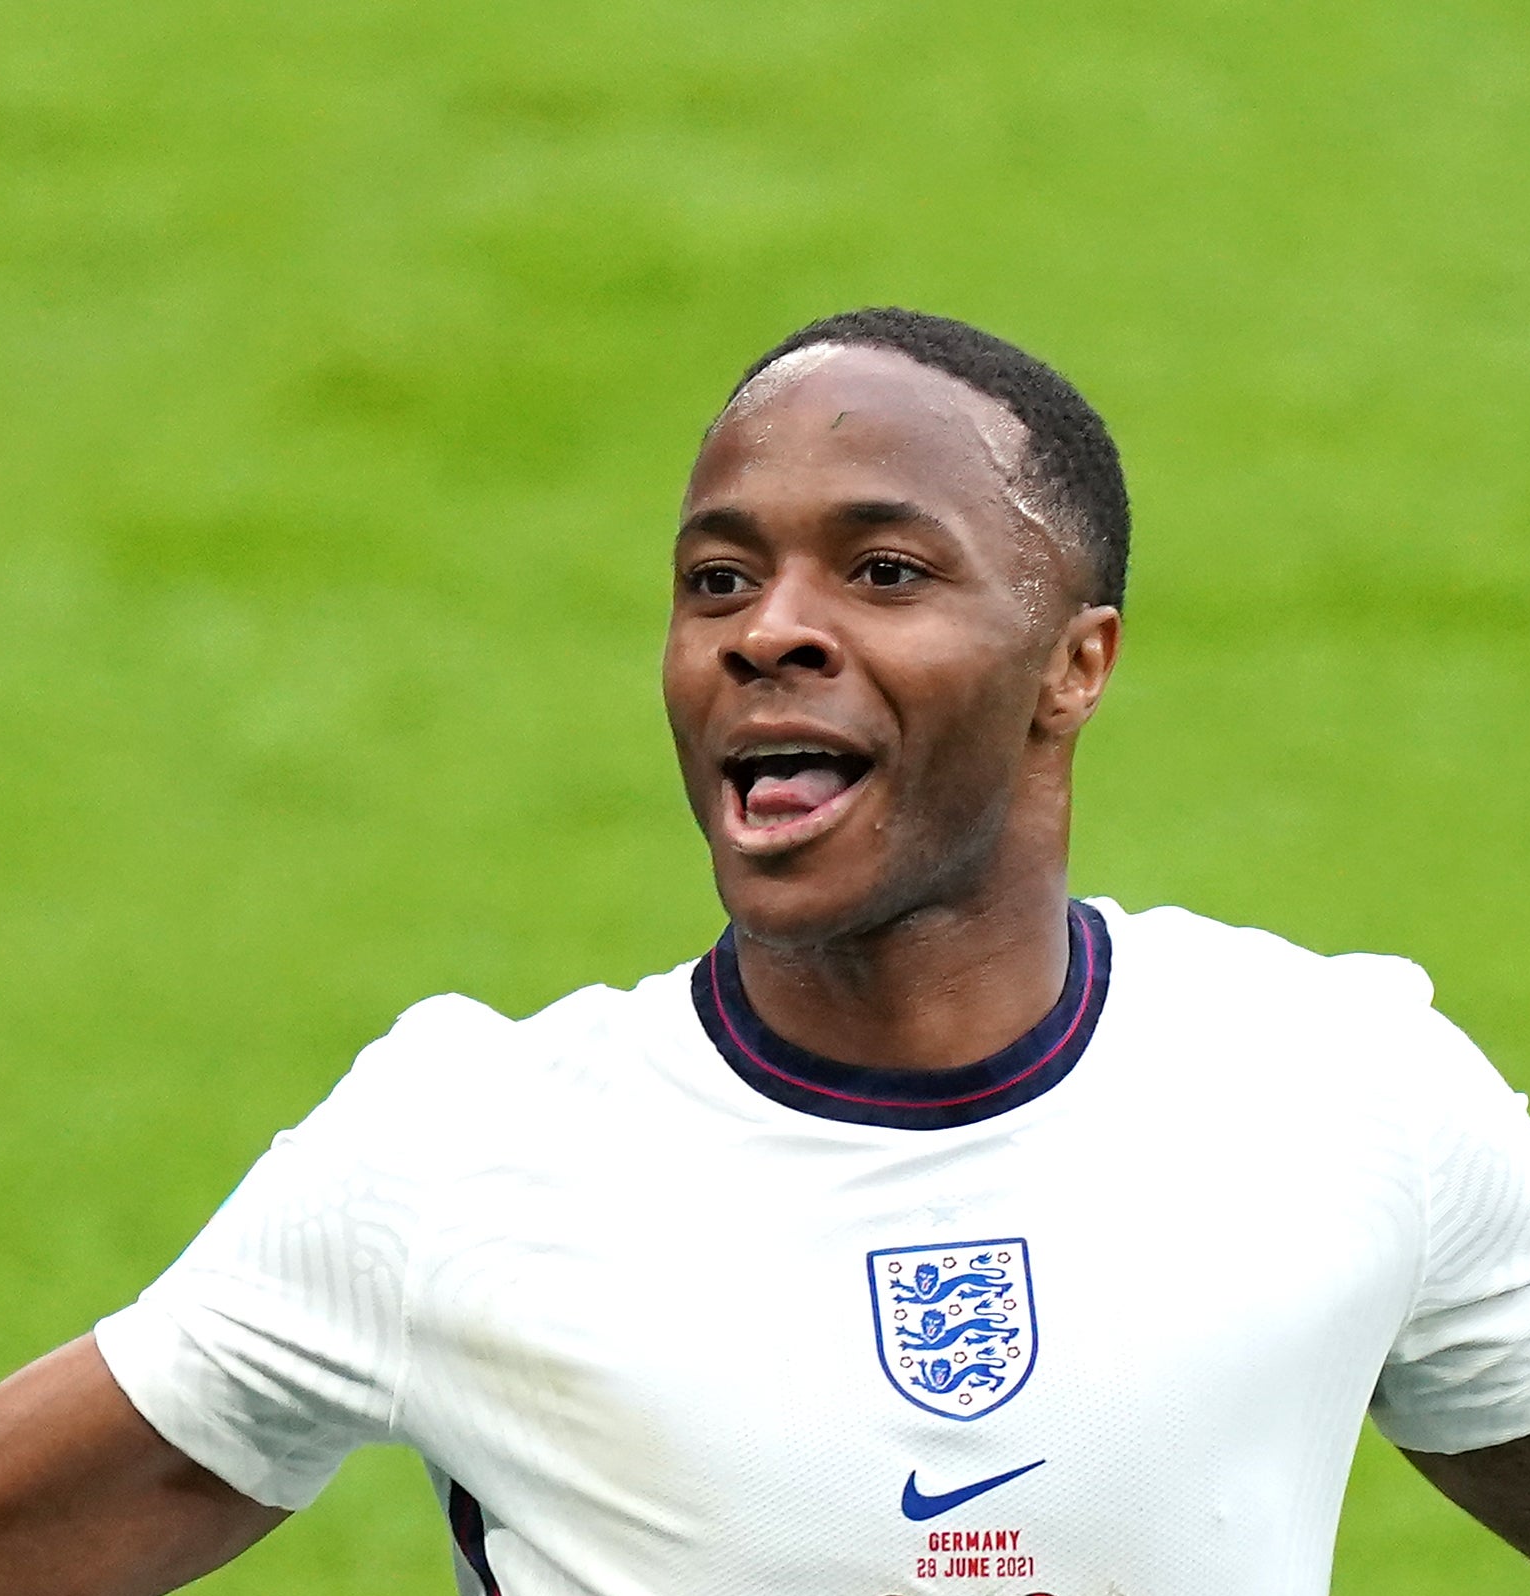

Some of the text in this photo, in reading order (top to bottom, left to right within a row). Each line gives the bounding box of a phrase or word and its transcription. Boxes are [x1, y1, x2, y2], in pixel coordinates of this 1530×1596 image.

[929, 1530, 1020, 1552] GERMANY
[944, 1557, 990, 1578] JUNE
[996, 1556, 1034, 1577] 2021
